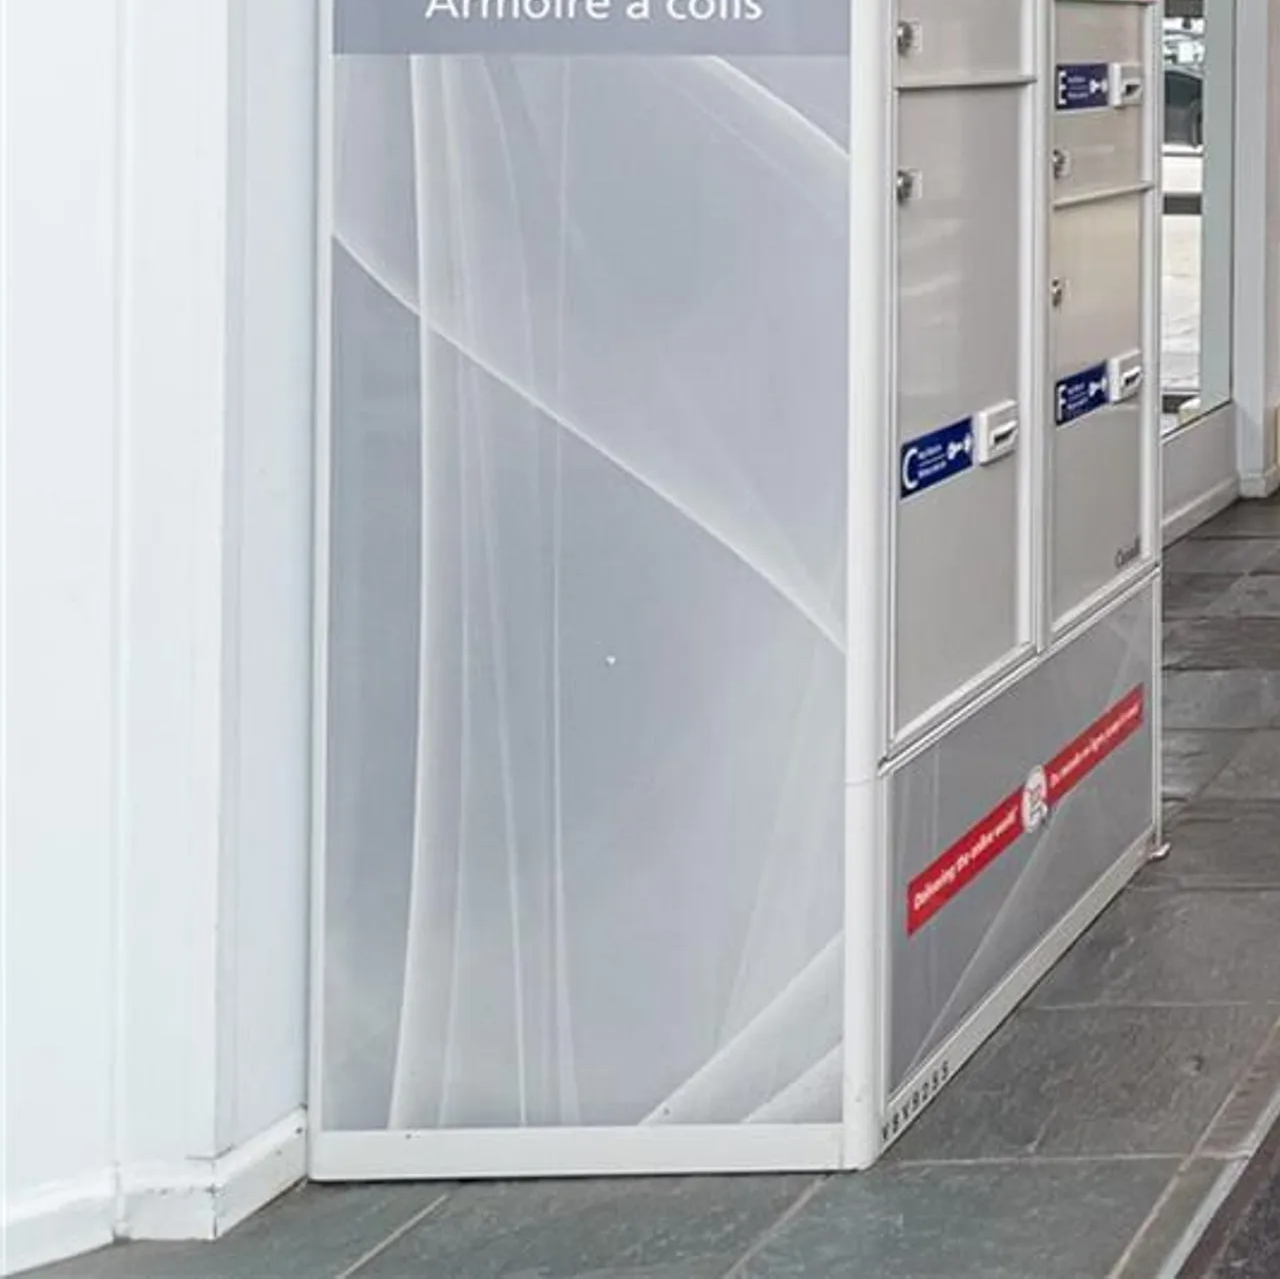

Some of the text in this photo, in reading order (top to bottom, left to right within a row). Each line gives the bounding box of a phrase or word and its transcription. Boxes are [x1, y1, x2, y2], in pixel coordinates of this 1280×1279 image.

[1057, 71, 1067, 105] E
[1058, 384, 1067, 420] F
[902, 449, 918, 490] C
